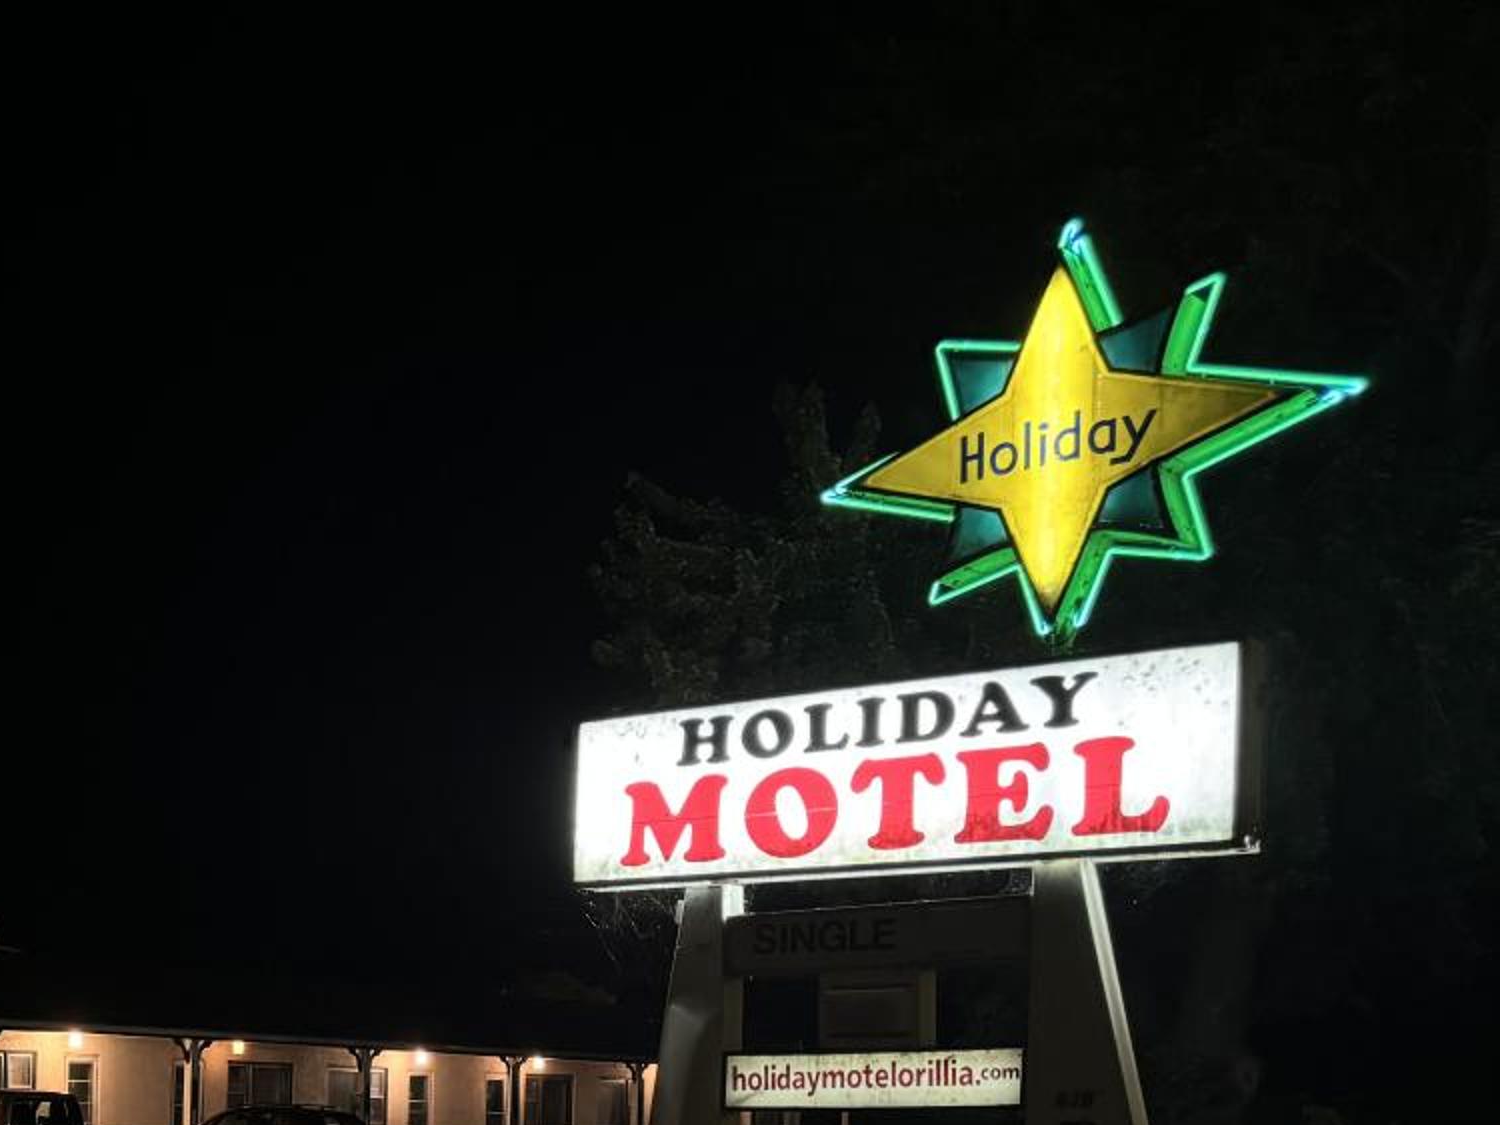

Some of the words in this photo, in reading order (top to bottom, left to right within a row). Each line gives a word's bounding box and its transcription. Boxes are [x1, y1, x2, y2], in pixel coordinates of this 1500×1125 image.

[959, 408, 1157, 484] Holiday
[676, 671, 1098, 766] HOLIDAY
[620, 735, 1170, 867] MOTEL
[753, 918, 896, 954] SINGLE
[731, 1057, 1019, 1096] holidaymotelorillia.com
